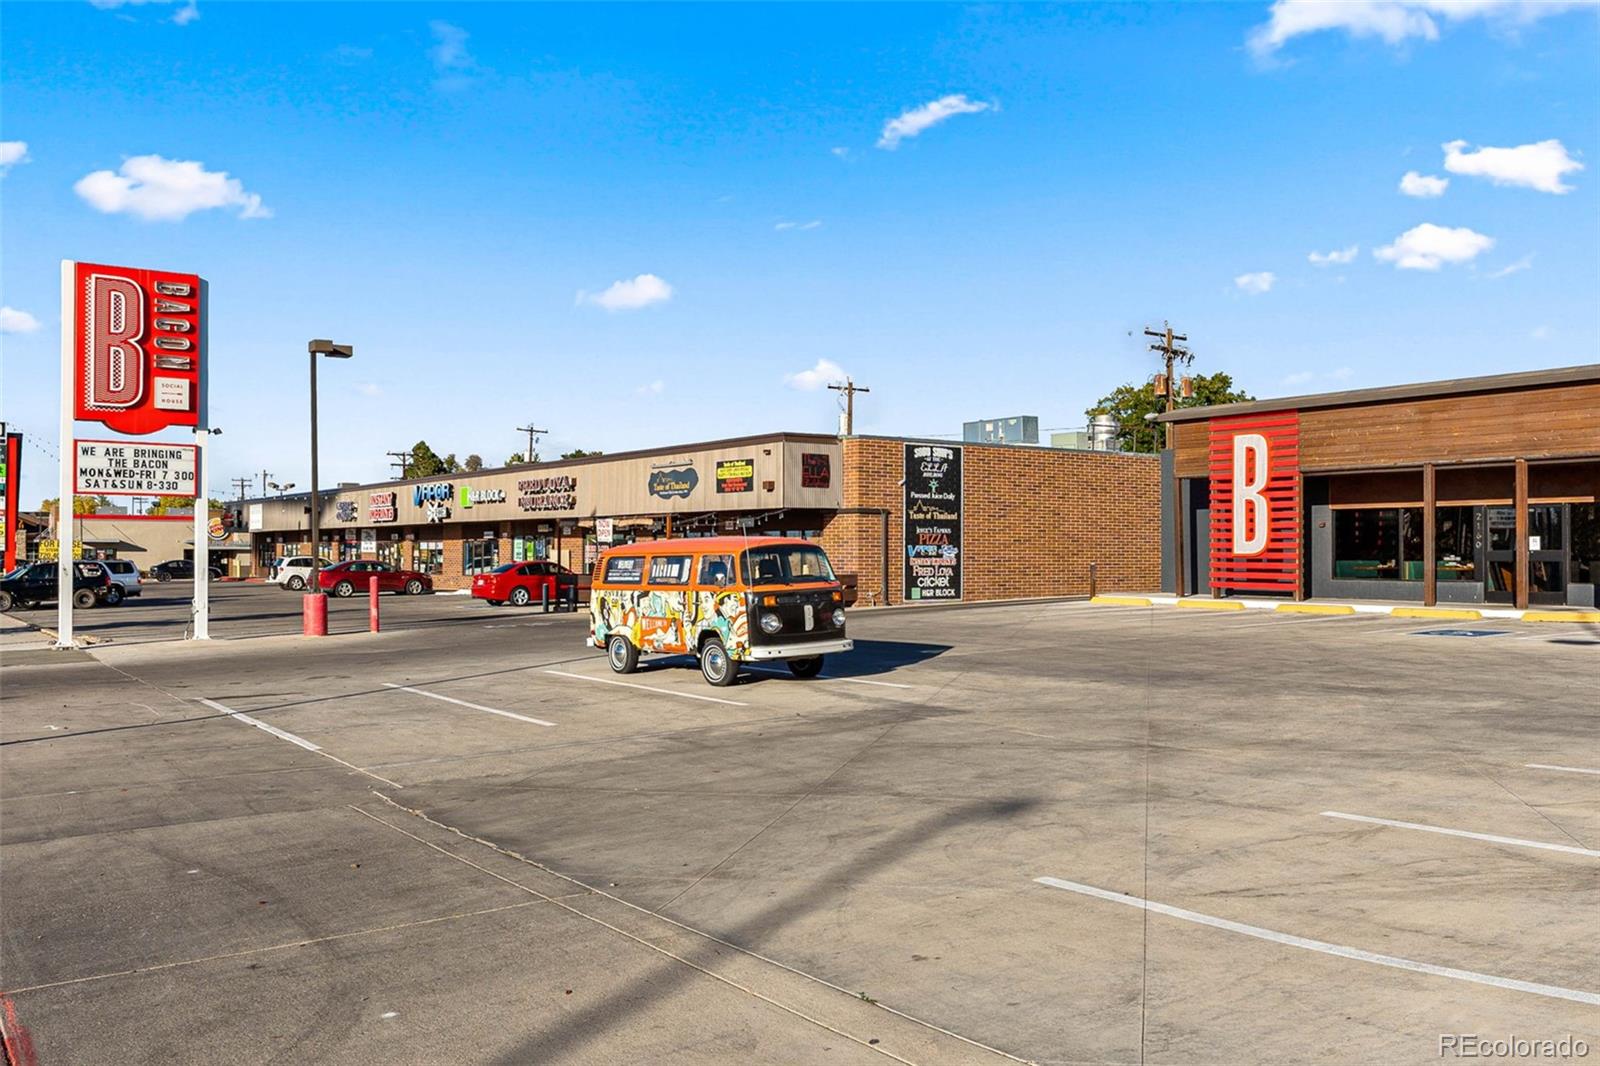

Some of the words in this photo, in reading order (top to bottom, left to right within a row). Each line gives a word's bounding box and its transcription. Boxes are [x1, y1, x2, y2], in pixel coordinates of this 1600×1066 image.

[154, 280, 190, 370] BACON
[85, 273, 144, 412] B
[81, 446, 96, 456] WE
[104, 447, 125, 457] ARE
[133, 448, 182, 460] BRINGING
[107, 458, 127, 468] THE
[133, 459, 168, 469] BACON
[162, 471, 168, 479] 7
[174, 471, 194, 481] 300
[85, 478, 142, 490] SAT&SUN
[413, 483, 450, 506] VAPOR
[1233, 433, 1270, 555] B
[919, 533, 949, 545] PIZZA
[917, 576, 950, 587] cricket
[935, 588, 955, 597] BLOCK
[804, 604, 815, 632] B
